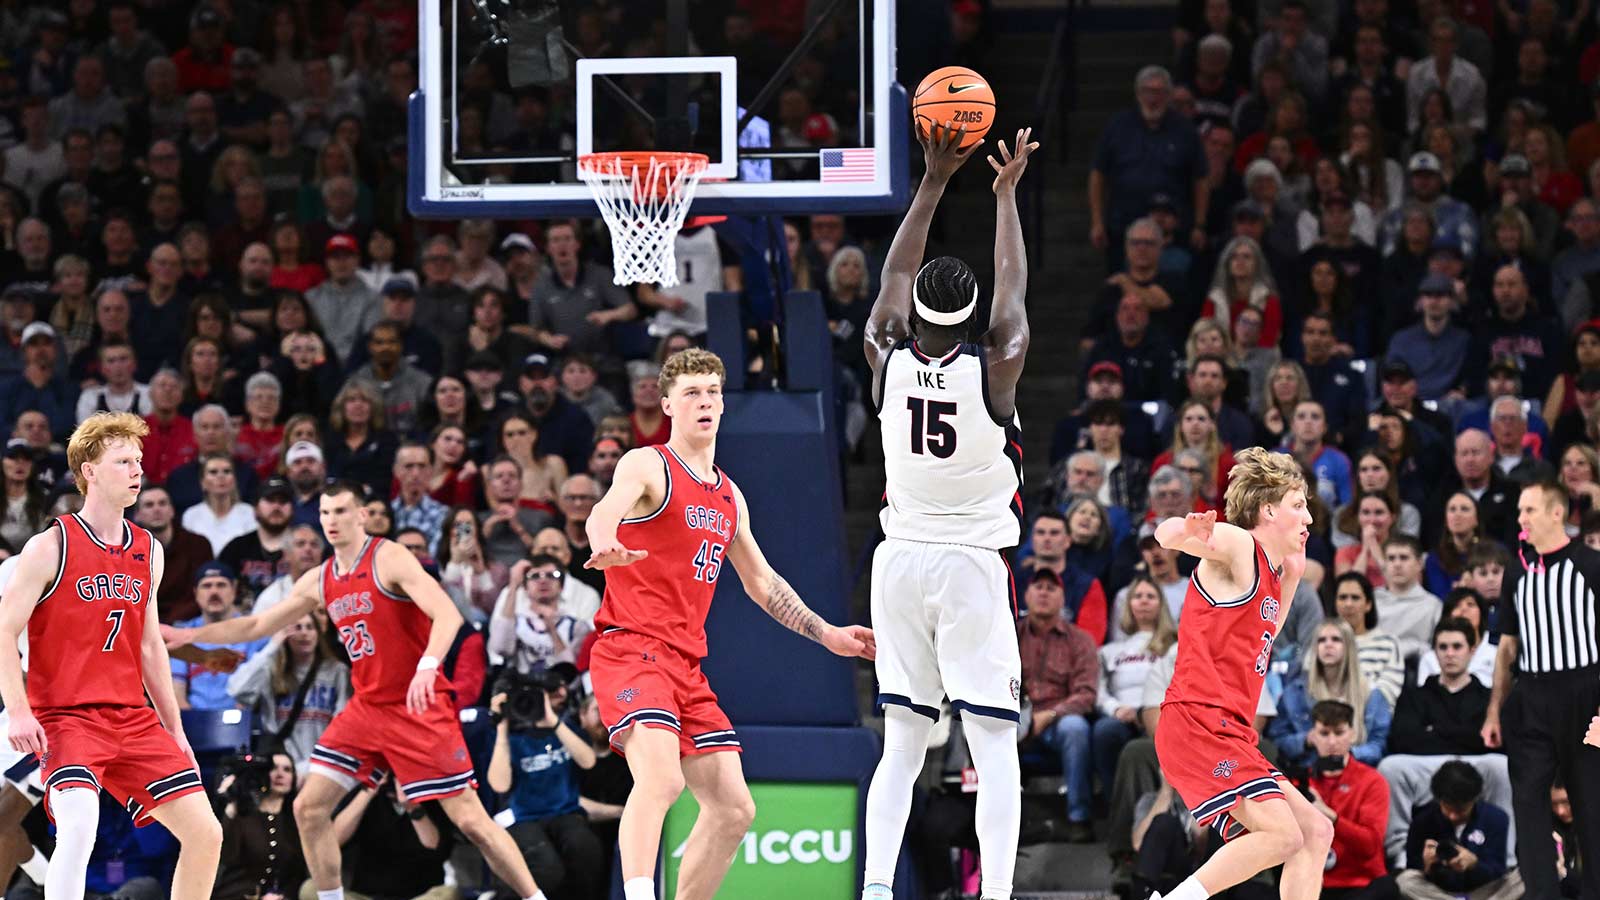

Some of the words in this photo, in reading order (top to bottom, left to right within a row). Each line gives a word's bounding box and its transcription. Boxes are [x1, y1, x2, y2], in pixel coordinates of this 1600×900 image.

[953, 110, 983, 123] ZAGS
[684, 259, 693, 284] 1
[917, 370, 946, 390] IKE
[906, 396, 958, 459] 15
[685, 504, 731, 542] GAELS
[692, 540, 725, 584] 45
[76, 573, 143, 604] GAELS
[102, 609, 125, 652] 7
[339, 620, 375, 662] 23
[743, 829, 853, 864] ICCU
